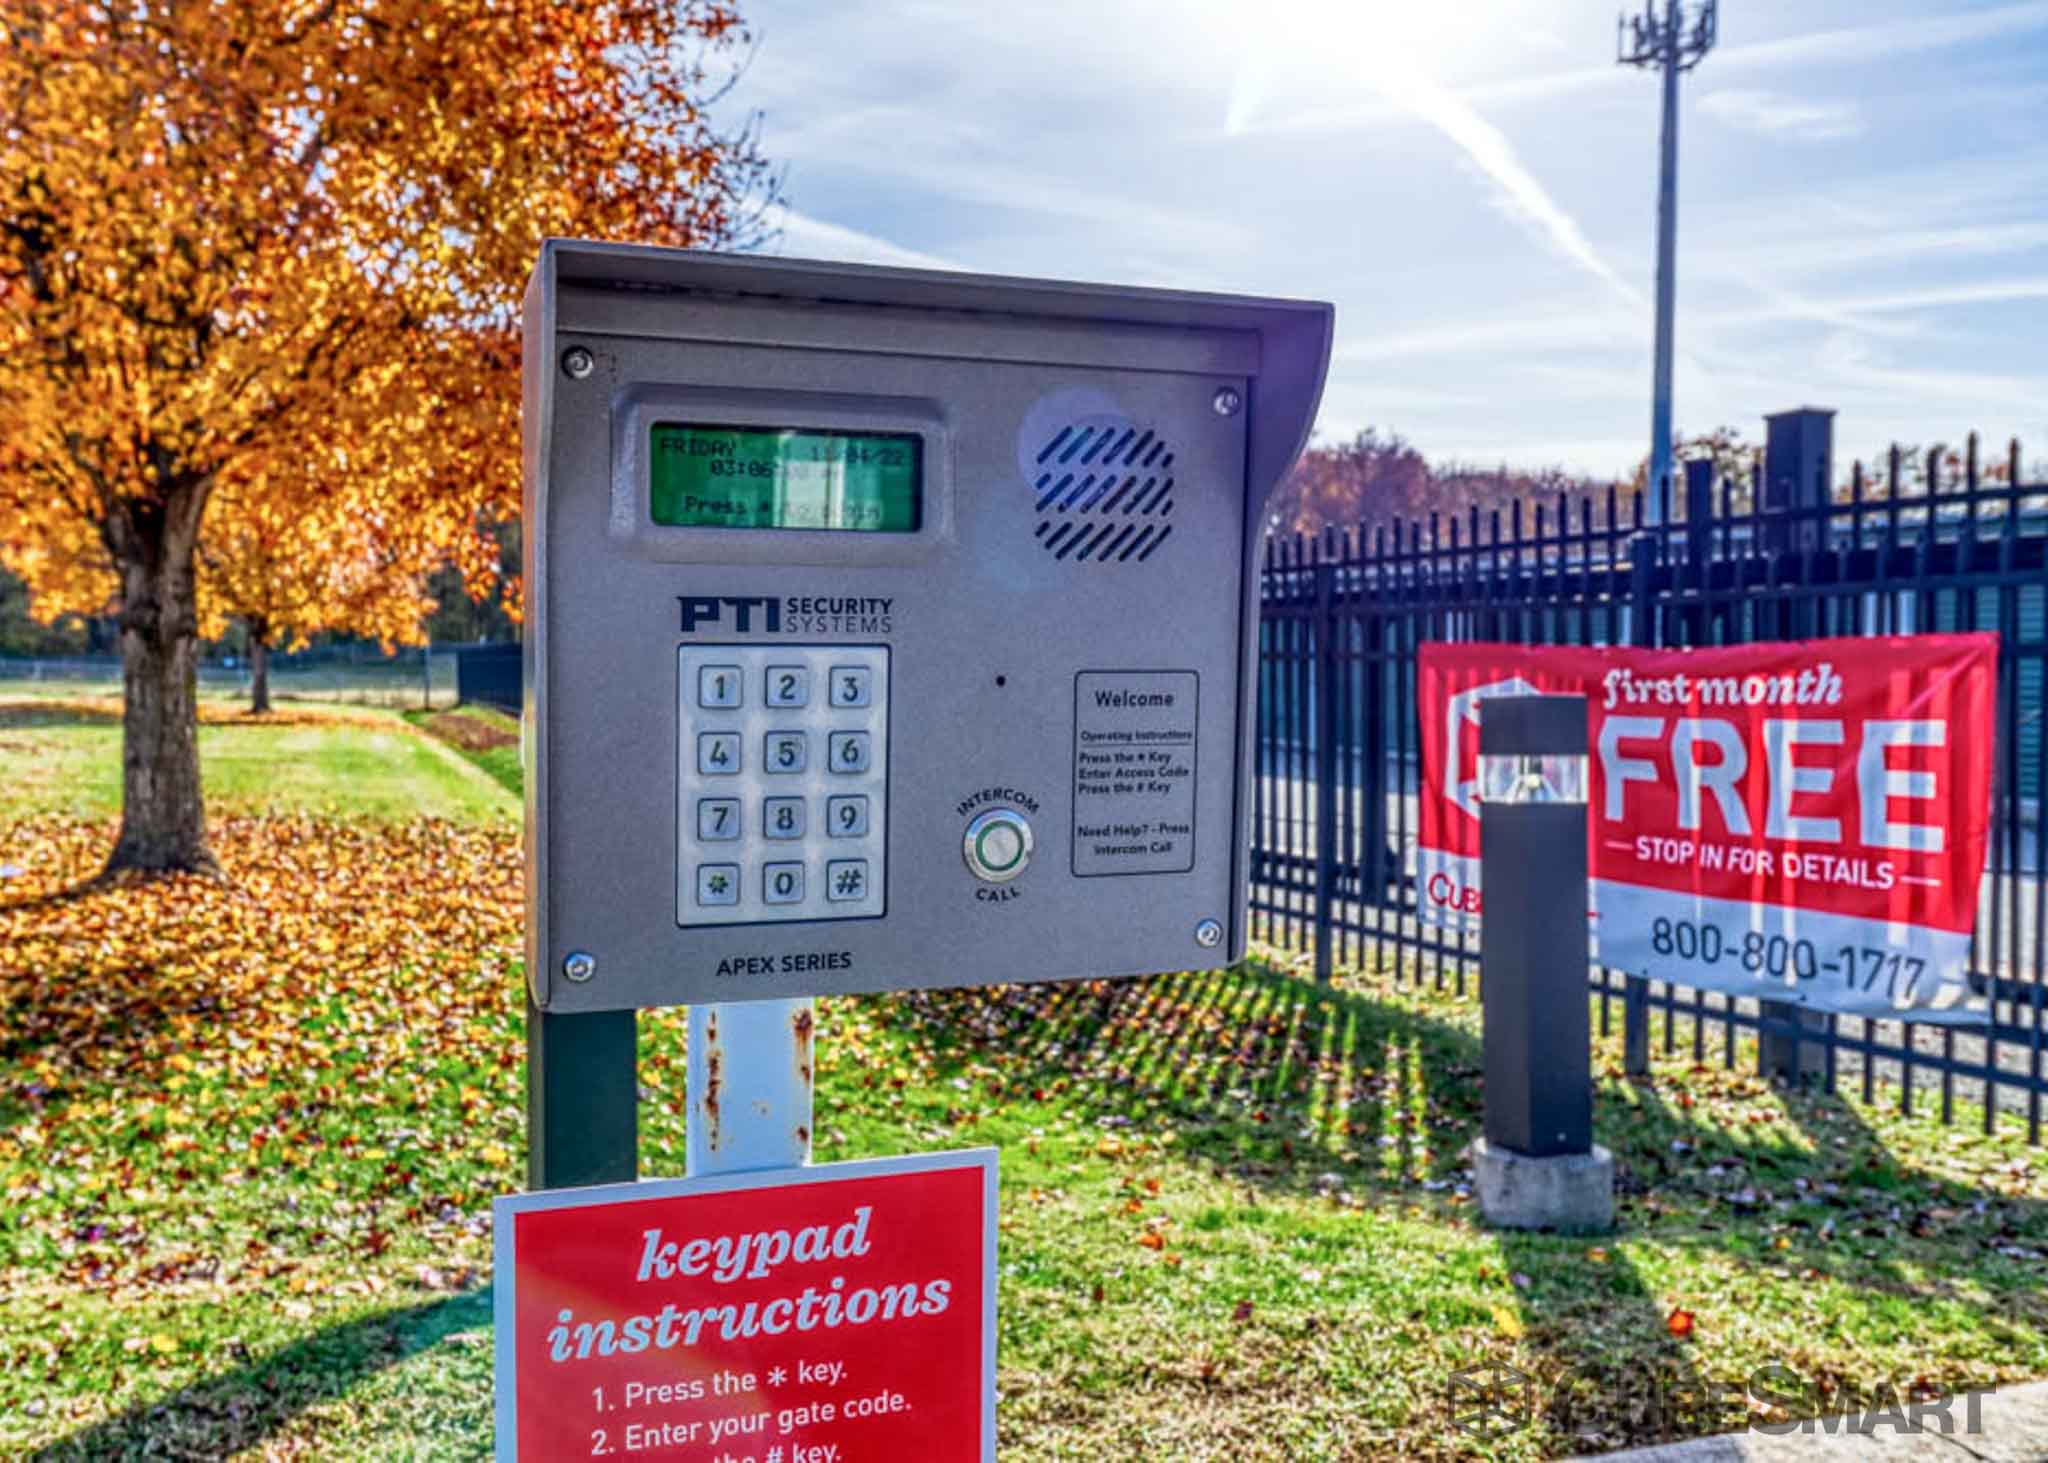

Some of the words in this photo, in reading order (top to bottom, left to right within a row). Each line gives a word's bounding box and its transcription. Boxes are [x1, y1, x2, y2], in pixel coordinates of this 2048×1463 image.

[661, 437, 736, 456] FRIDAY
[684, 495, 748, 514] Press
[676, 596, 780, 632] PTI
[786, 597, 893, 615] SECURITY
[786, 616, 892, 633] SYSTEMS
[714, 675, 725, 700] 1
[779, 674, 796, 700] 2
[842, 676, 859, 702] 3
[1095, 689, 1174, 707] Welcome
[1603, 668, 1693, 709] first
[1697, 663, 1843, 706] month
[1081, 730, 1132, 741] Operating
[1136, 728, 1192, 740] Instructions
[710, 741, 728, 766] 4
[778, 741, 795, 766] 5
[842, 739, 859, 763] 6
[1079, 752, 1111, 763] Press
[1149, 751, 1171, 765] Key
[1079, 767, 1111, 779] Enter
[1115, 767, 1155, 779] Access
[1158, 765, 1189, 778] Code
[1598, 716, 1946, 853] FREE
[1078, 782, 1110, 794] Press
[1113, 781, 1134, 793] the
[1148, 780, 1171, 795] Key
[956, 787, 1039, 816] INTERCOM
[712, 807, 728, 832] 7
[776, 806, 794, 831] 8
[839, 805, 857, 829] 9
[1078, 824, 1110, 836] Need
[1113, 823, 1149, 837] Help?
[1160, 822, 1189, 834] Press
[1094, 845, 1147, 855] Intercom
[1150, 841, 1171, 853] Call
[1636, 836, 1694, 866] STOP
[1701, 844, 1722, 869] IN
[1727, 847, 1773, 876] FOR
[1783, 853, 1896, 889] DETAILS
[774, 871, 793, 895] 0
[836, 868, 862, 894] #
[976, 887, 1021, 901] CALL
[1428, 872, 1483, 913] CUB
[716, 956, 774, 976] APEX
[781, 951, 852, 972] SERIES
[1652, 916, 1925, 1003] 800-800-1717
[636, 1206, 873, 1284] keypad
[547, 1278, 953, 1363] instructions
[592, 1387, 616, 1413] 1.
[626, 1379, 705, 1408] Press
[712, 1370, 757, 1396] the
[799, 1359, 848, 1386] key.
[591, 1429, 615, 1456] 2.
[626, 1423, 703, 1451] Enter
[708, 1412, 772, 1446] your
[777, 1403, 836, 1435] gate
[843, 1389, 913, 1420] code.
